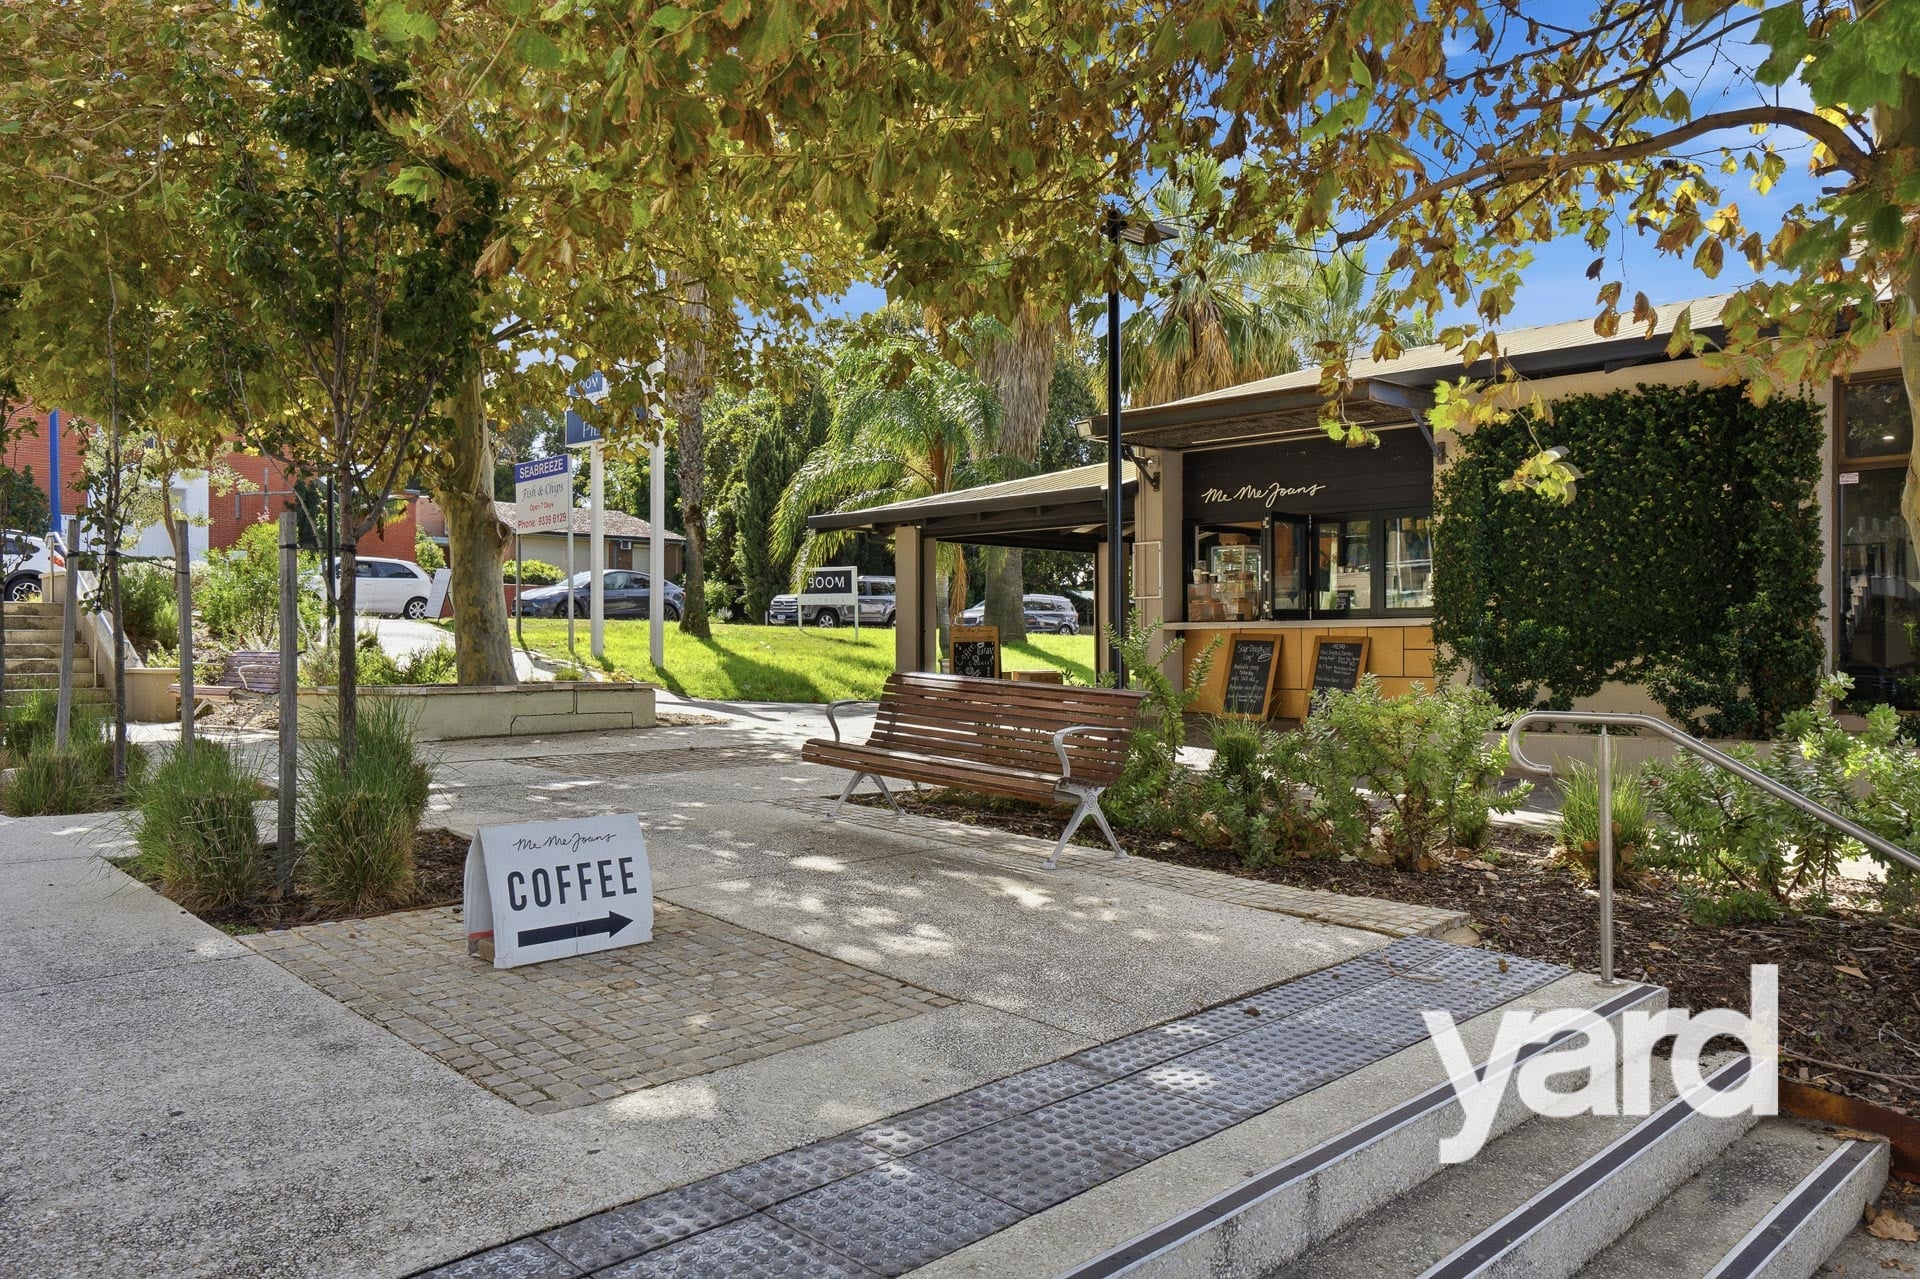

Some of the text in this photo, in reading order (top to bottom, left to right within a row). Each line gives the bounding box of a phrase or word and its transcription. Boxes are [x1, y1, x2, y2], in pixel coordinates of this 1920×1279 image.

[519, 459, 564, 479] SEABREEZE
[522, 481, 564, 502] Fish & Chips
[1201, 487, 1232, 503] Me
[1233, 485, 1269, 500] Me
[808, 576, 845, 588] BOOM
[512, 838, 541, 851] Me
[543, 835, 573, 847] Me
[507, 856, 638, 911] COFFEE
